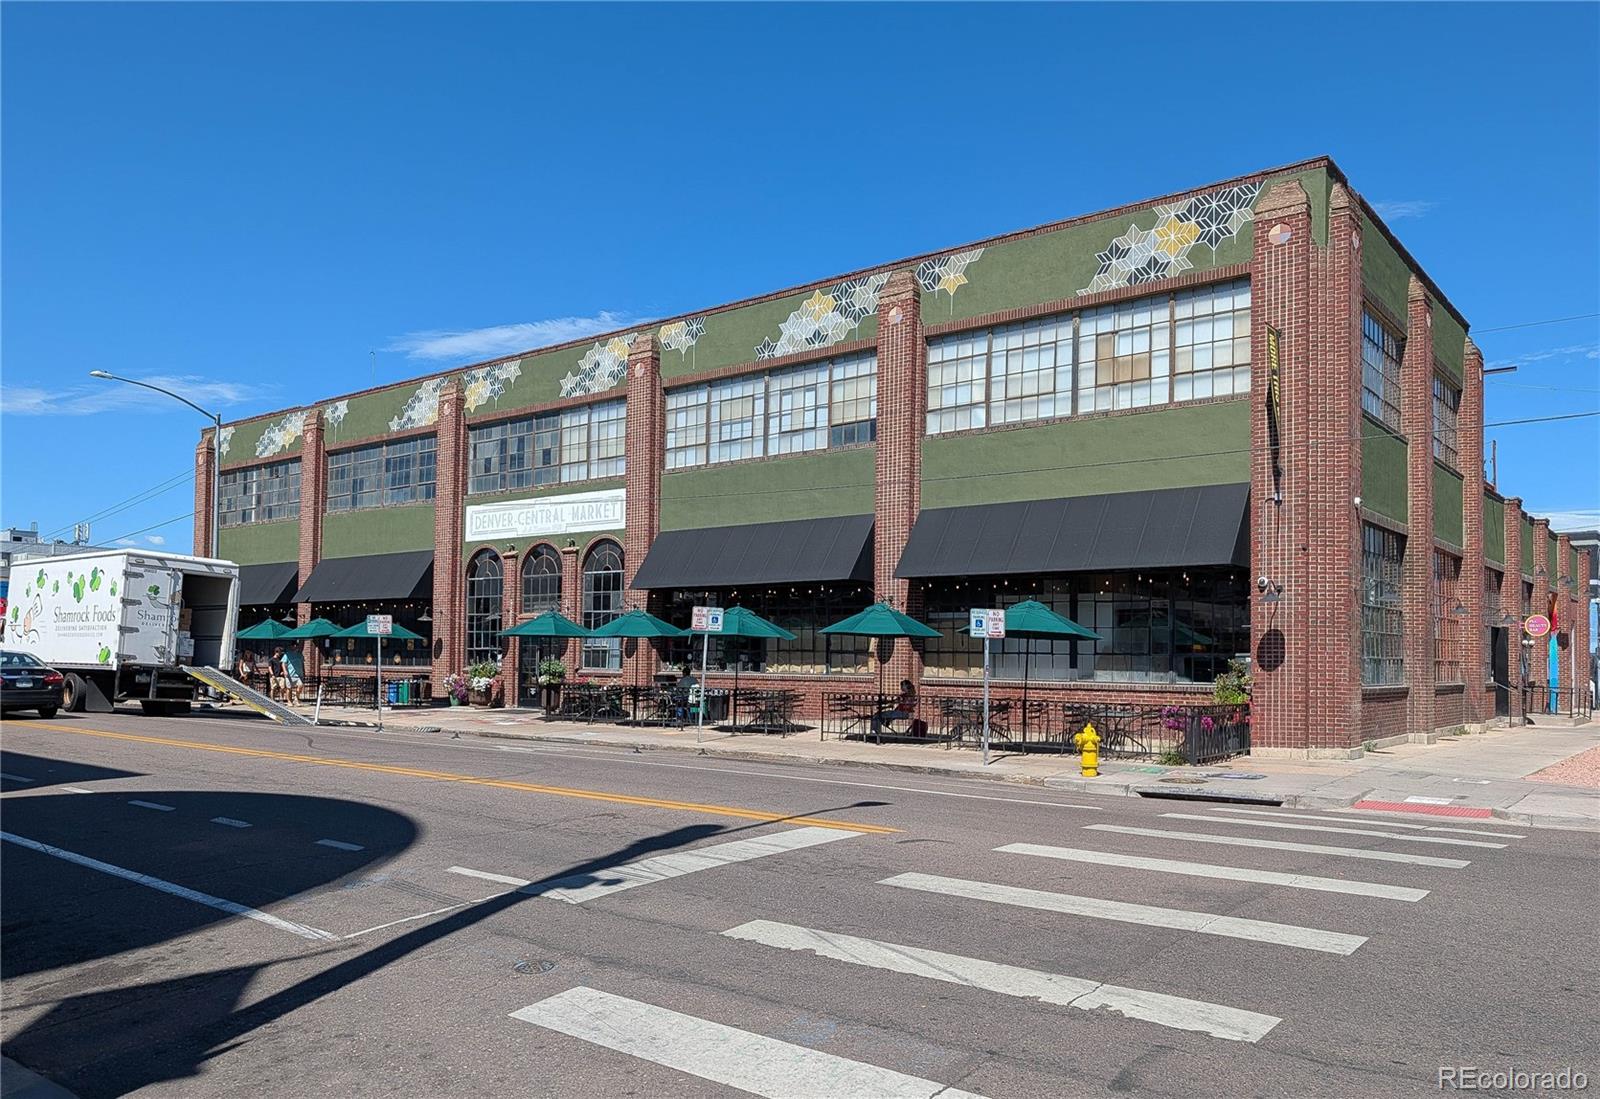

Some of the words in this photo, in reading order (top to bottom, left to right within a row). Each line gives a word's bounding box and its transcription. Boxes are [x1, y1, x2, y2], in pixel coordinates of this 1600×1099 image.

[474, 512, 514, 531] DENVER
[517, 505, 566, 526] CENTRAL
[571, 502, 619, 521] MARKET
[53, 606, 90, 624] Shamrock
[92, 604, 116, 622] Foods
